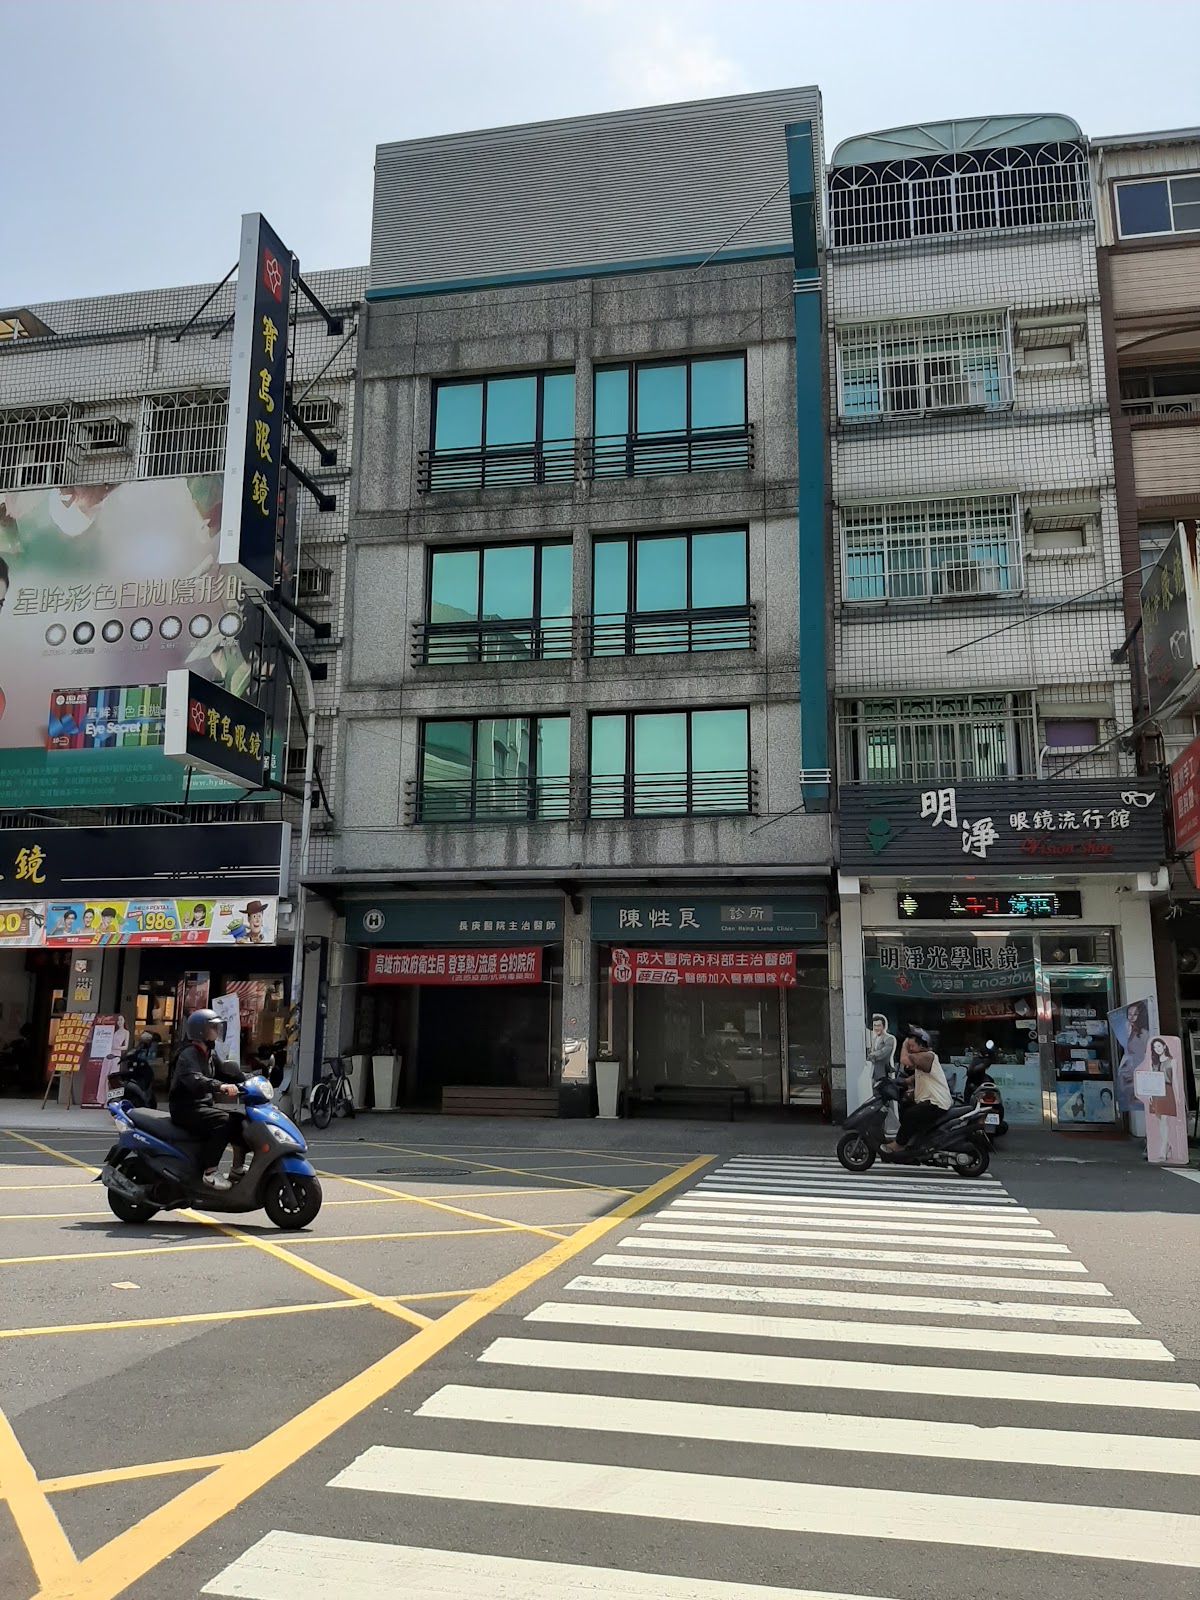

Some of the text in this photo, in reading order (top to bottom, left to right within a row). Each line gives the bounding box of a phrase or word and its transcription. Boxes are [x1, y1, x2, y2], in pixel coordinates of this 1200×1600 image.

[251, 315, 279, 516] 寶島眼鏡
[85, 722, 105, 737] Eye
[106, 721, 141, 733] Secret
[207, 708, 262, 761] 寶島眼鏡
[1009, 808, 1131, 831] 眼鏡流行館
[136, 911, 176, 931] 1980
[619, 906, 701, 929] 陳性良
[729, 906, 765, 920] 診所
[458, 920, 557, 931] 長庚醫院主治醫師
[499, 951, 536, 973] 合約院所
[879, 945, 1019, 970] 明淨光學眼鏡
[684, 972, 778, 984] 醫師加入醫療團隊
